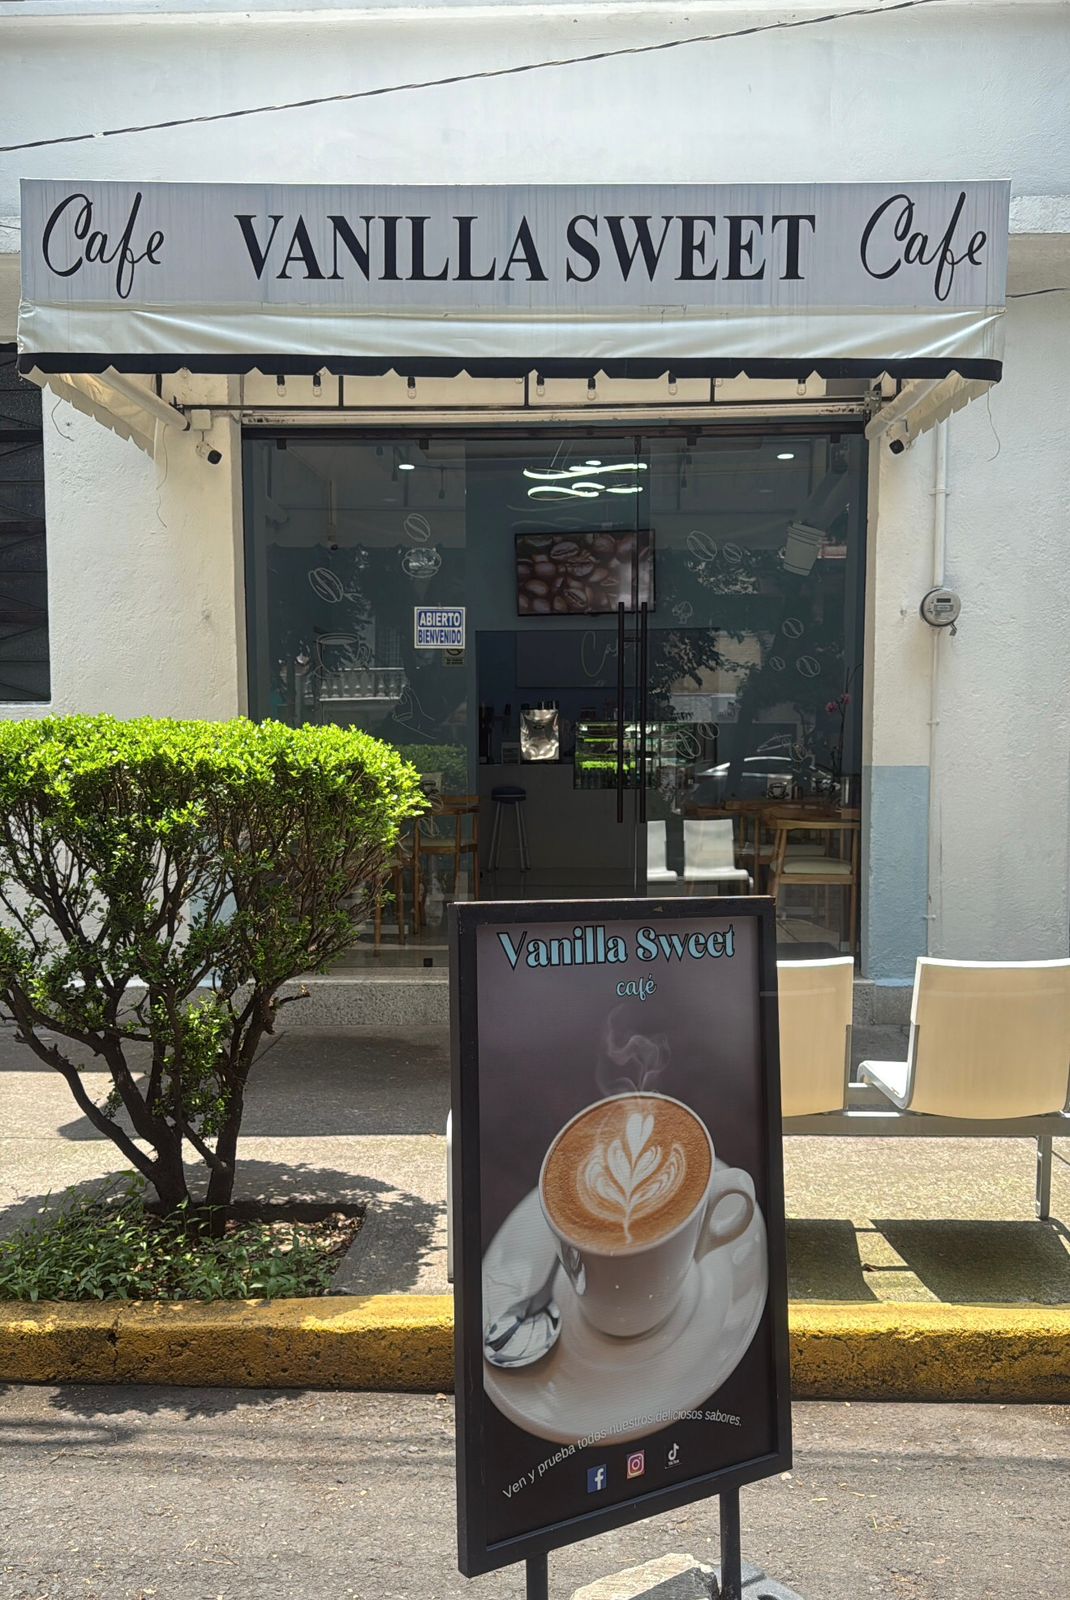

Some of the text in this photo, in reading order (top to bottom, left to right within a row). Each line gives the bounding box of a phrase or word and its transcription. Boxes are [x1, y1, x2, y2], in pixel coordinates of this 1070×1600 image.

[42, 191, 165, 299] Cafe
[234, 214, 816, 282] VANILLA SWEET
[860, 191, 988, 301] Cafe
[418, 629, 462, 643] BIENVENIDO
[419, 612, 461, 626] ABIERTO
[497, 924, 735, 970] Vanilla Sweet
[616, 974, 657, 1000] café
[502, 1477, 527, 1498] Ven
[527, 1469, 535, 1484] y
[537, 1444, 576, 1477] prueba
[608, 1413, 653, 1434] nuestros
[655, 1407, 703, 1424] deliciosos
[704, 1409, 742, 1427] sabores.
